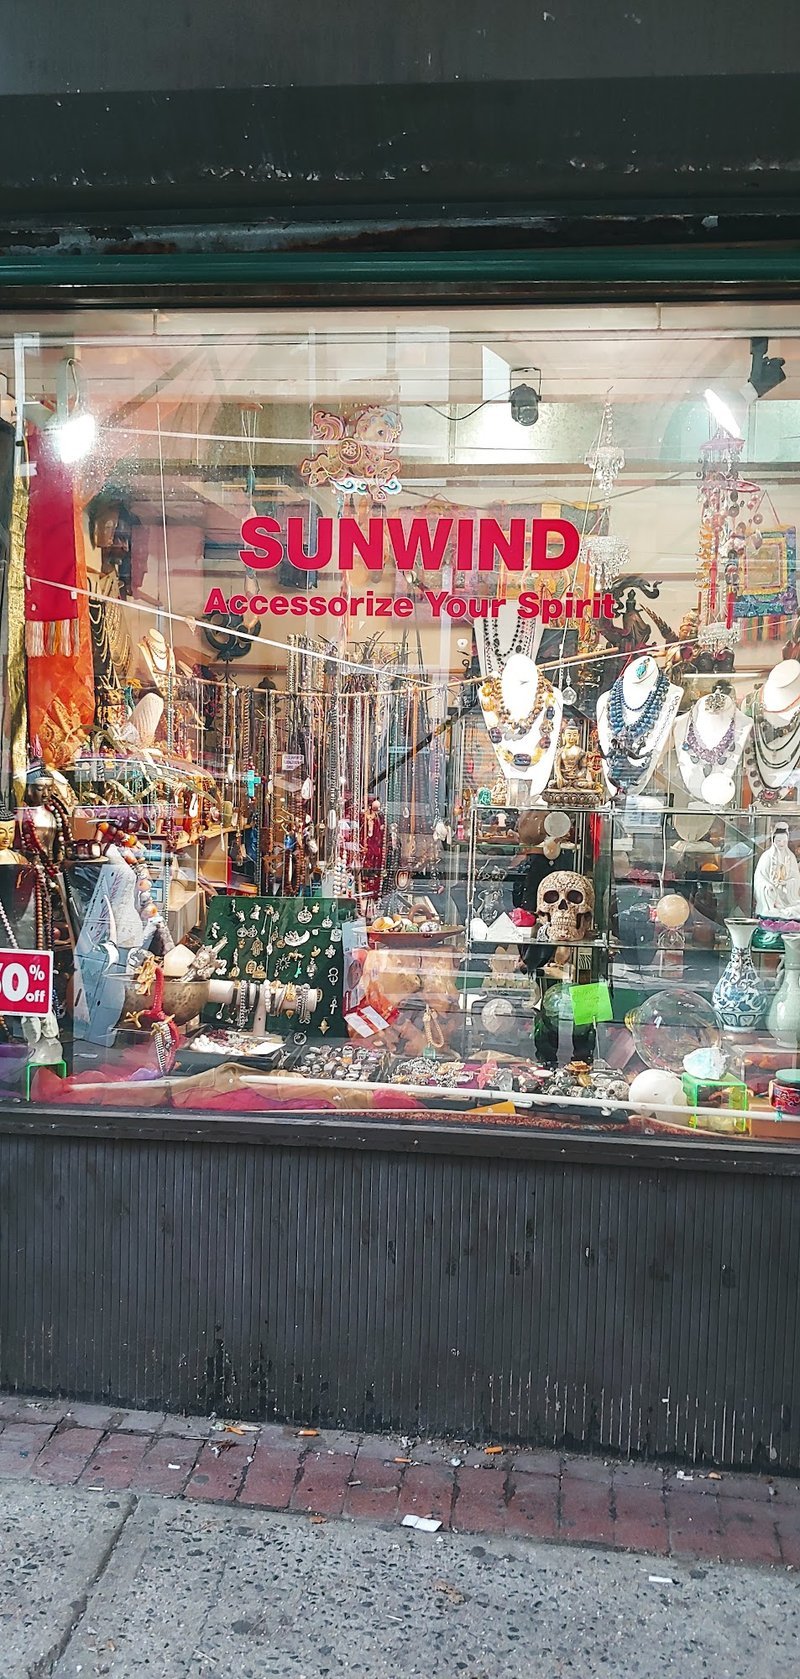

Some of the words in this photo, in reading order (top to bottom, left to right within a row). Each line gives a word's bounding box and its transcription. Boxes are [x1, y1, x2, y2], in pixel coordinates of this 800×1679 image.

[239, 516, 581, 571] SUNWIND
[204, 588, 415, 619] Accessorize
[426, 591, 507, 619] Your
[518, 591, 617, 625] Spirit
[0, 962, 46, 1002] 0%
[25, 989, 46, 1003] off
